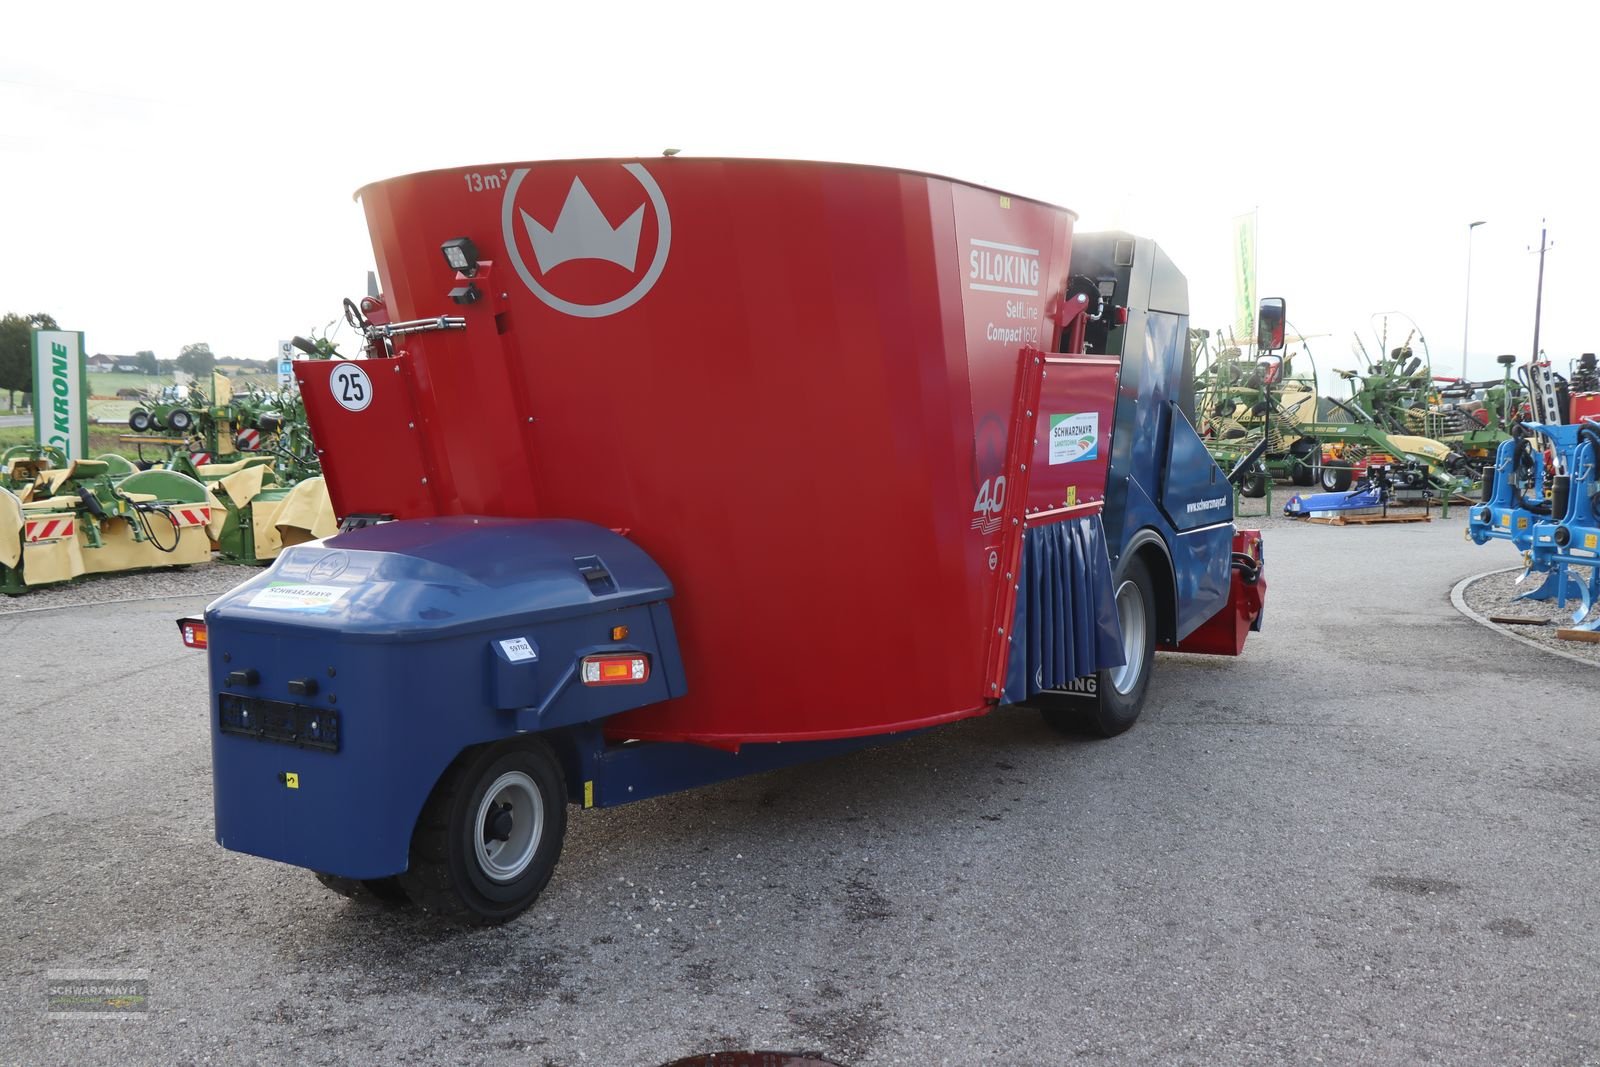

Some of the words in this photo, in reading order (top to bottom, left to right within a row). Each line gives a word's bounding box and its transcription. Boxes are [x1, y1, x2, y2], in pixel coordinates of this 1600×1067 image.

[970, 250, 1039, 286] SILOKING
[1006, 300, 1038, 319] SelfLine
[987, 322, 1022, 346] Compact
[1023, 326, 1037, 343] 1612
[52, 342, 69, 434] KRONE
[338, 374, 364, 401] 25
[1054, 424, 1092, 437] SCHWARZMAYR
[1186, 495, 1227, 513] www.schwarzmayr.at
[269, 587, 332, 598] SCHWARZMAYR
